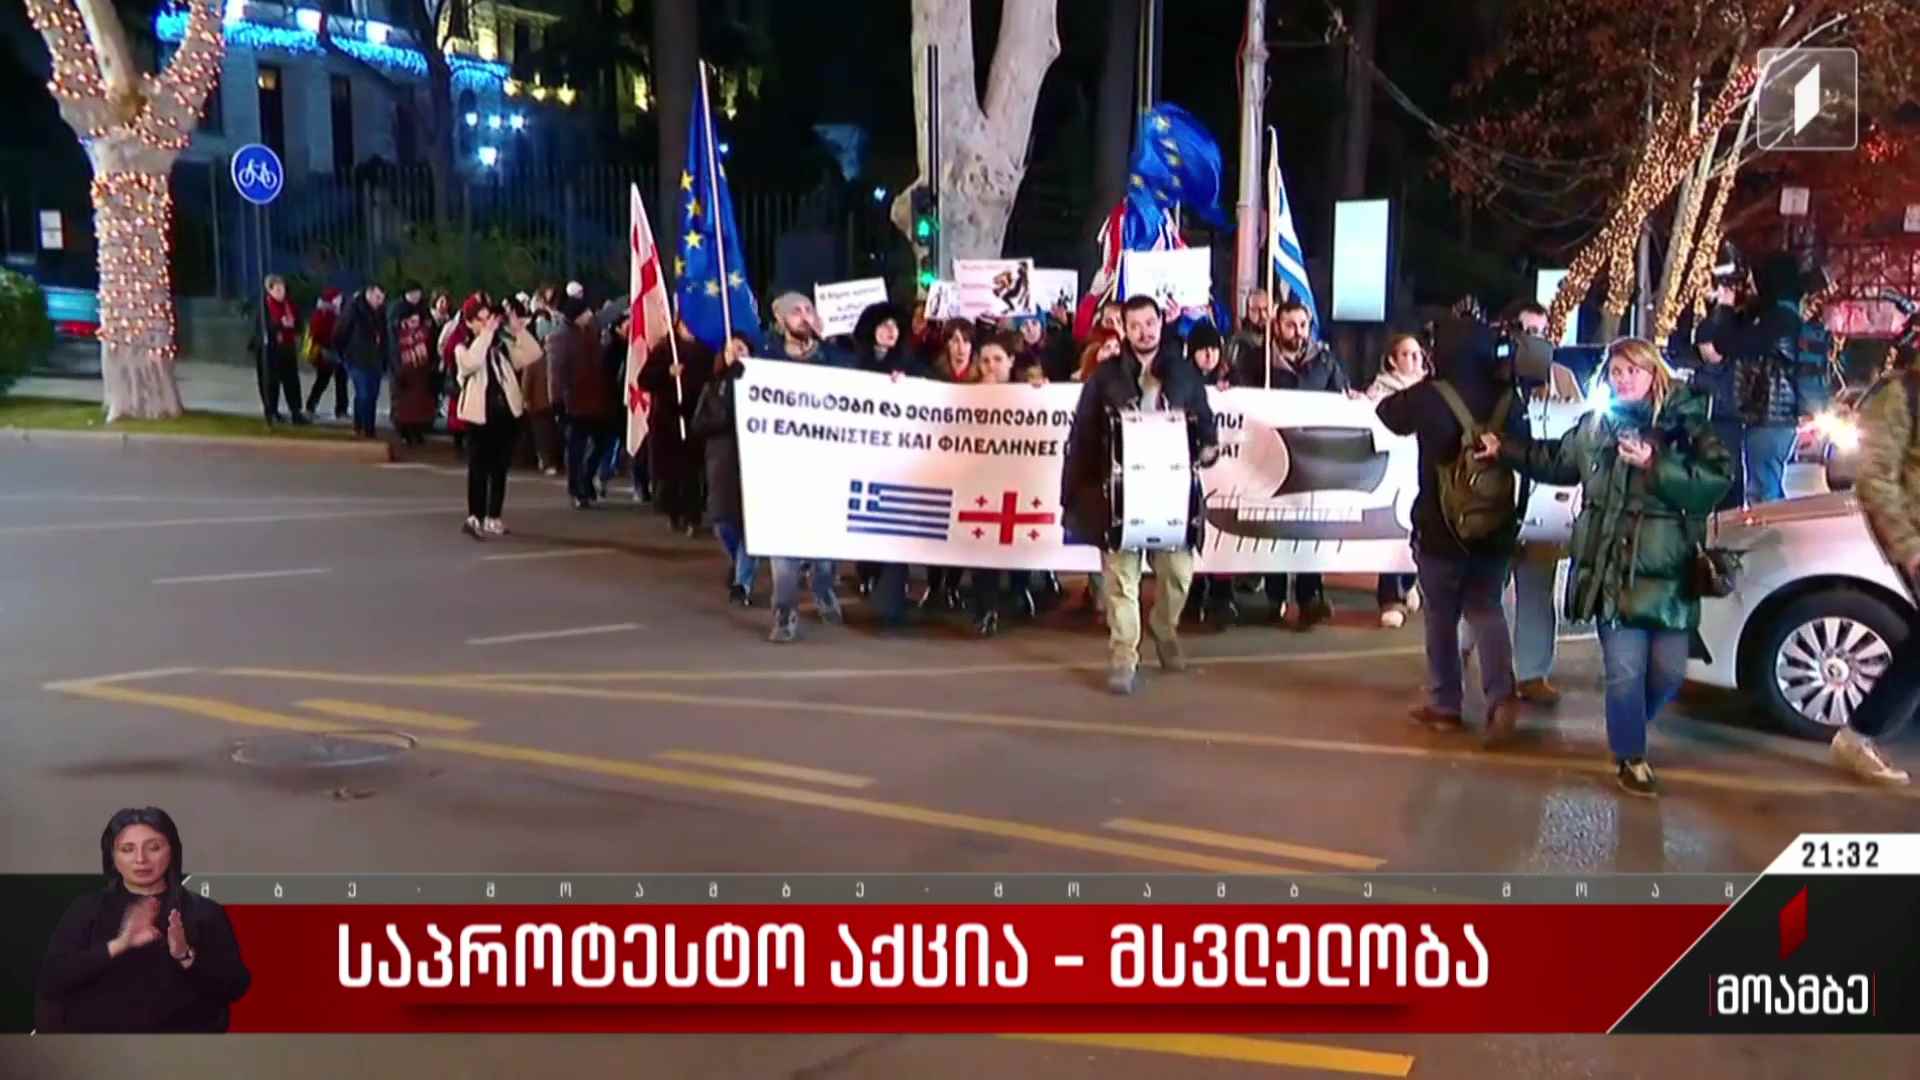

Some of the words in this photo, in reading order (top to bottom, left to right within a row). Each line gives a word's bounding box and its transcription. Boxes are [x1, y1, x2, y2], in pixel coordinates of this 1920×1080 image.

[747, 385, 875, 416] ელინისტები
[879, 401, 902, 419] და
[905, 405, 1048, 427] ელინოფილები
[747, 417, 768, 434] ΟΙ
[773, 419, 893, 448] ΕΛΛΗΝΙΣΤΕΣ
[898, 431, 932, 450] ΚΑΙ
[937, 435, 1059, 457] ΦΙΛΕΛΛΗΝΕΣ
